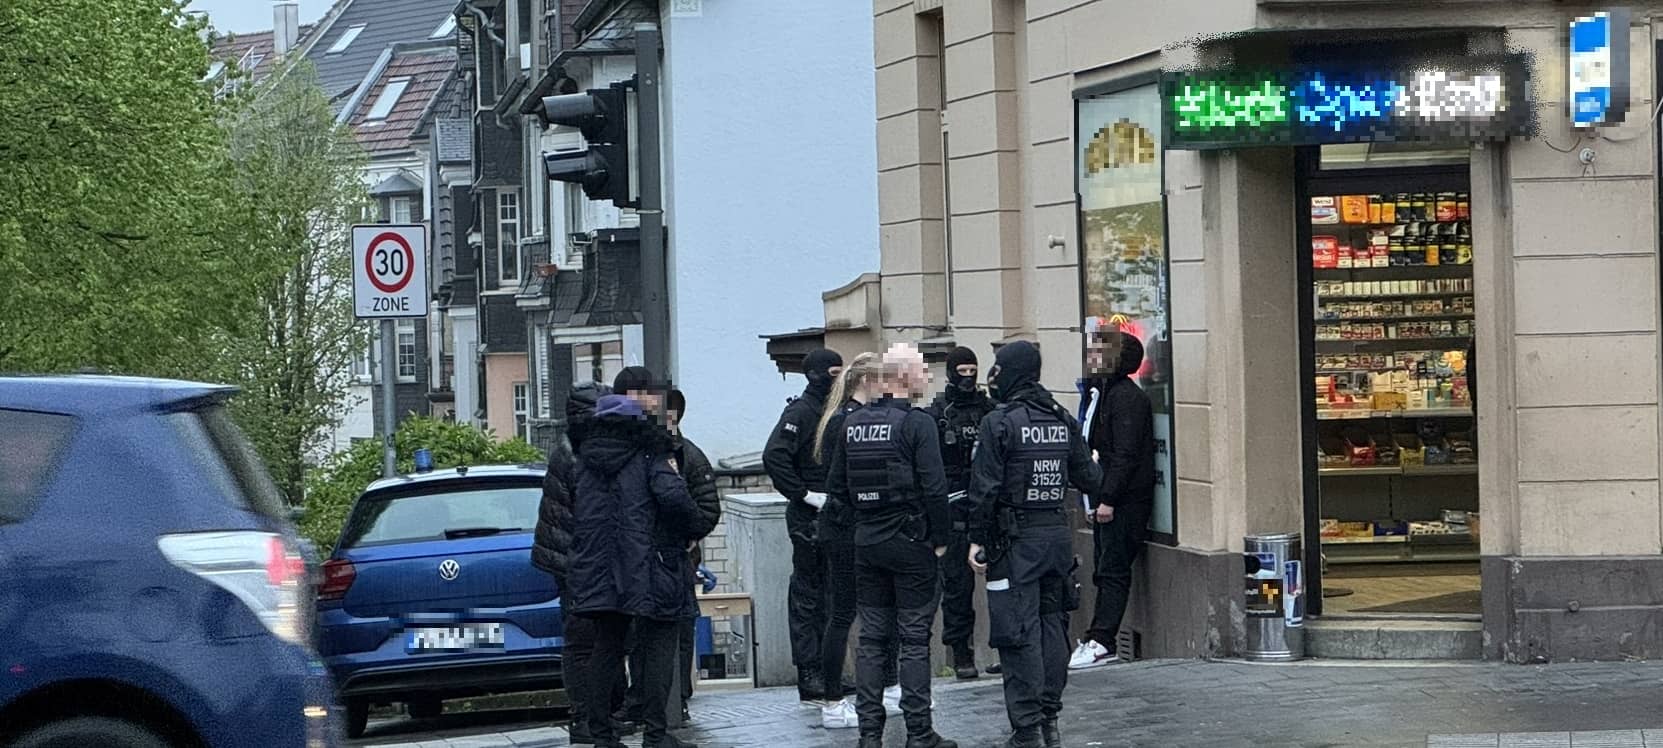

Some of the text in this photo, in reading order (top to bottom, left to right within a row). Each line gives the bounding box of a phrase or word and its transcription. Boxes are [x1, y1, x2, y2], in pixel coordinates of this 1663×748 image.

[376, 249, 403, 276] 30
[372, 297, 409, 312] ZONE
[847, 424, 892, 443] POLIZEI
[1021, 425, 1069, 444] POLIZEI
[1033, 459, 1061, 473] NRW
[1031, 473, 1062, 486] 31522
[857, 492, 879, 501] POLIZEI
[1027, 487, 1064, 501] BeSi
